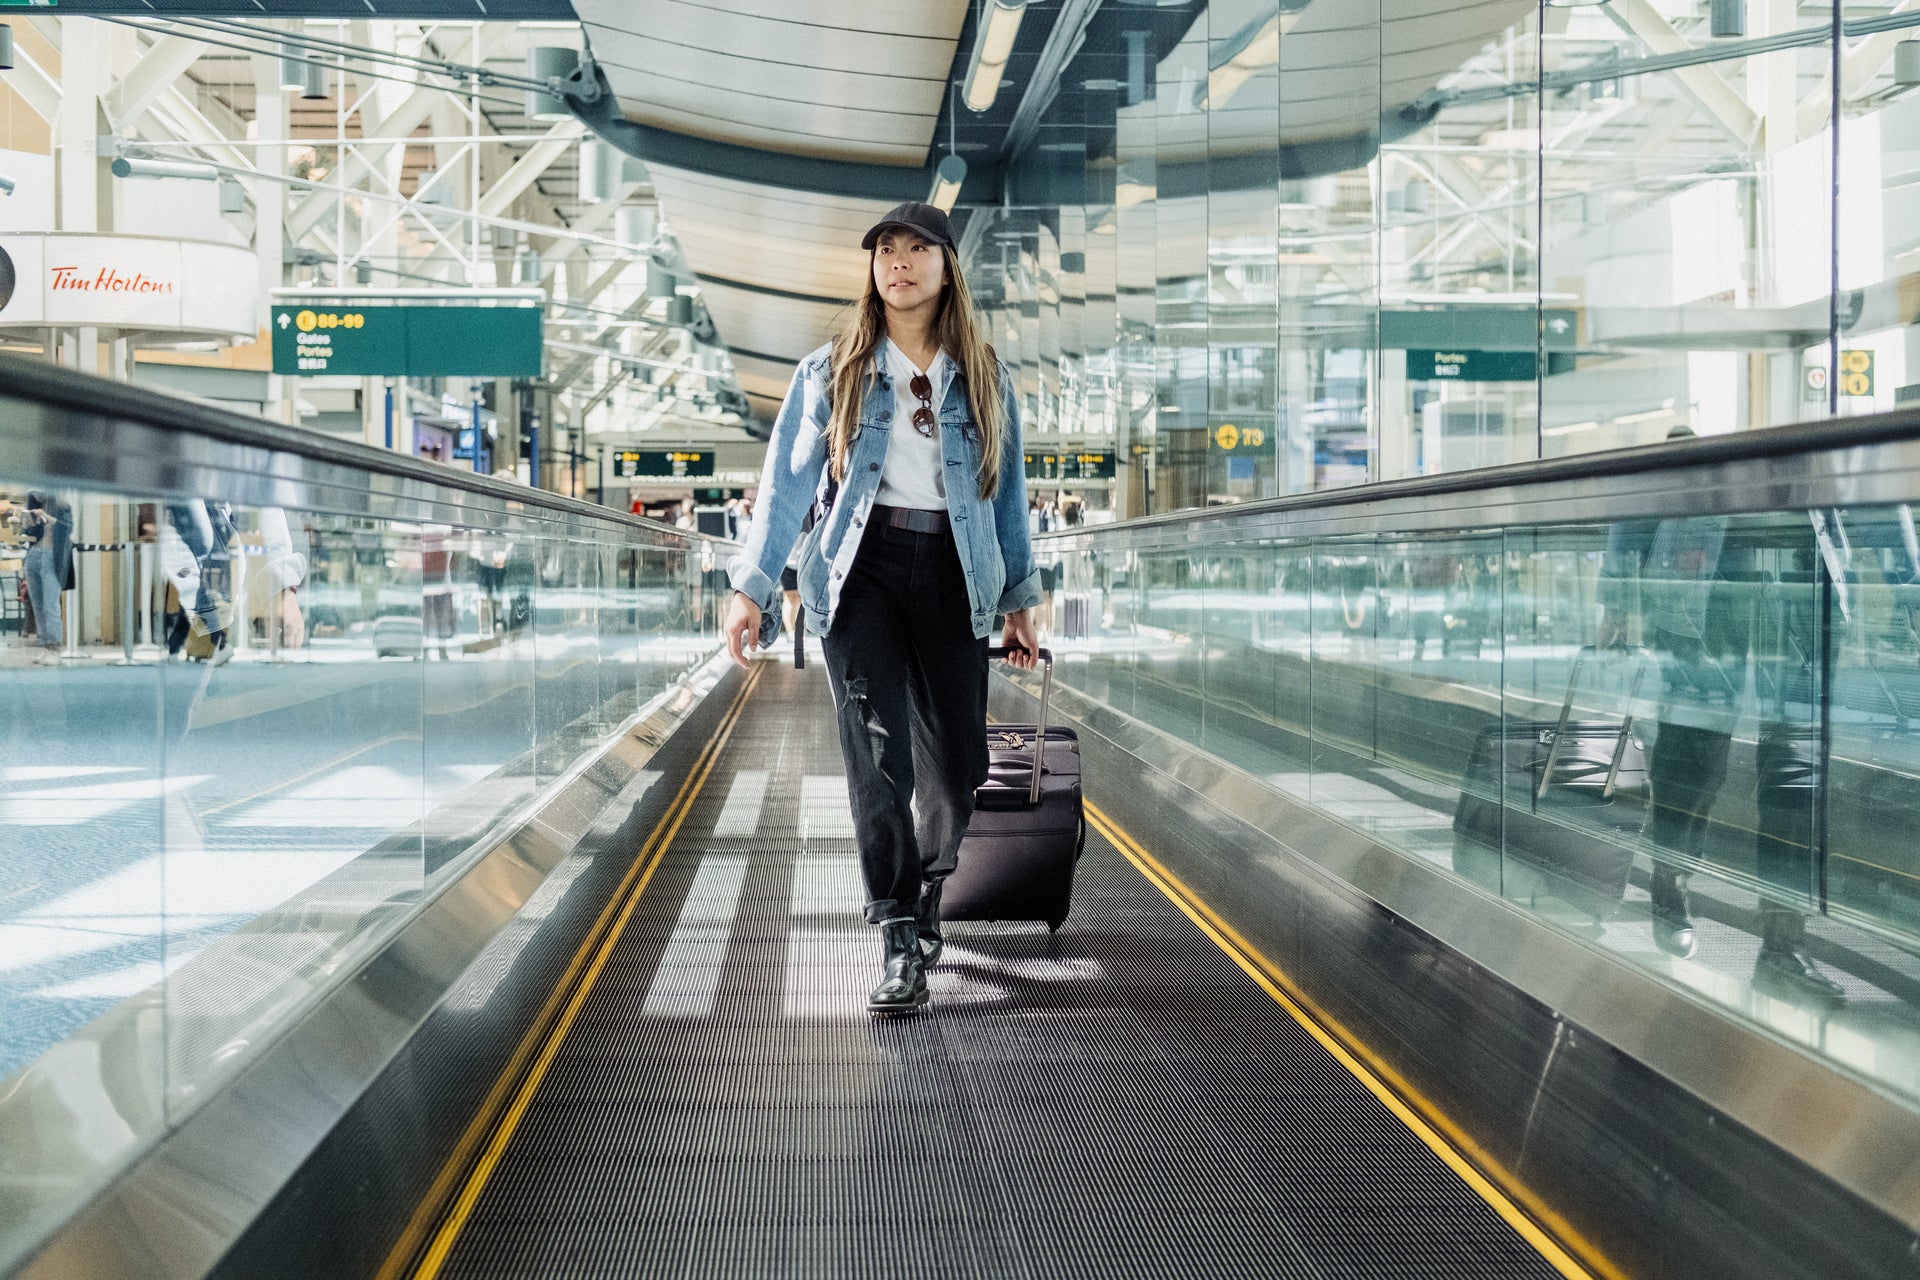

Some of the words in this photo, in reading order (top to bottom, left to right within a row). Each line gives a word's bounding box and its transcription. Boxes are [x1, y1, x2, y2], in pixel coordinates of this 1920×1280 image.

[51, 267, 90, 291] Tim
[94, 267, 173, 294] Hortons
[296, 332, 331, 345] Gates
[296, 345, 333, 357] Portes
